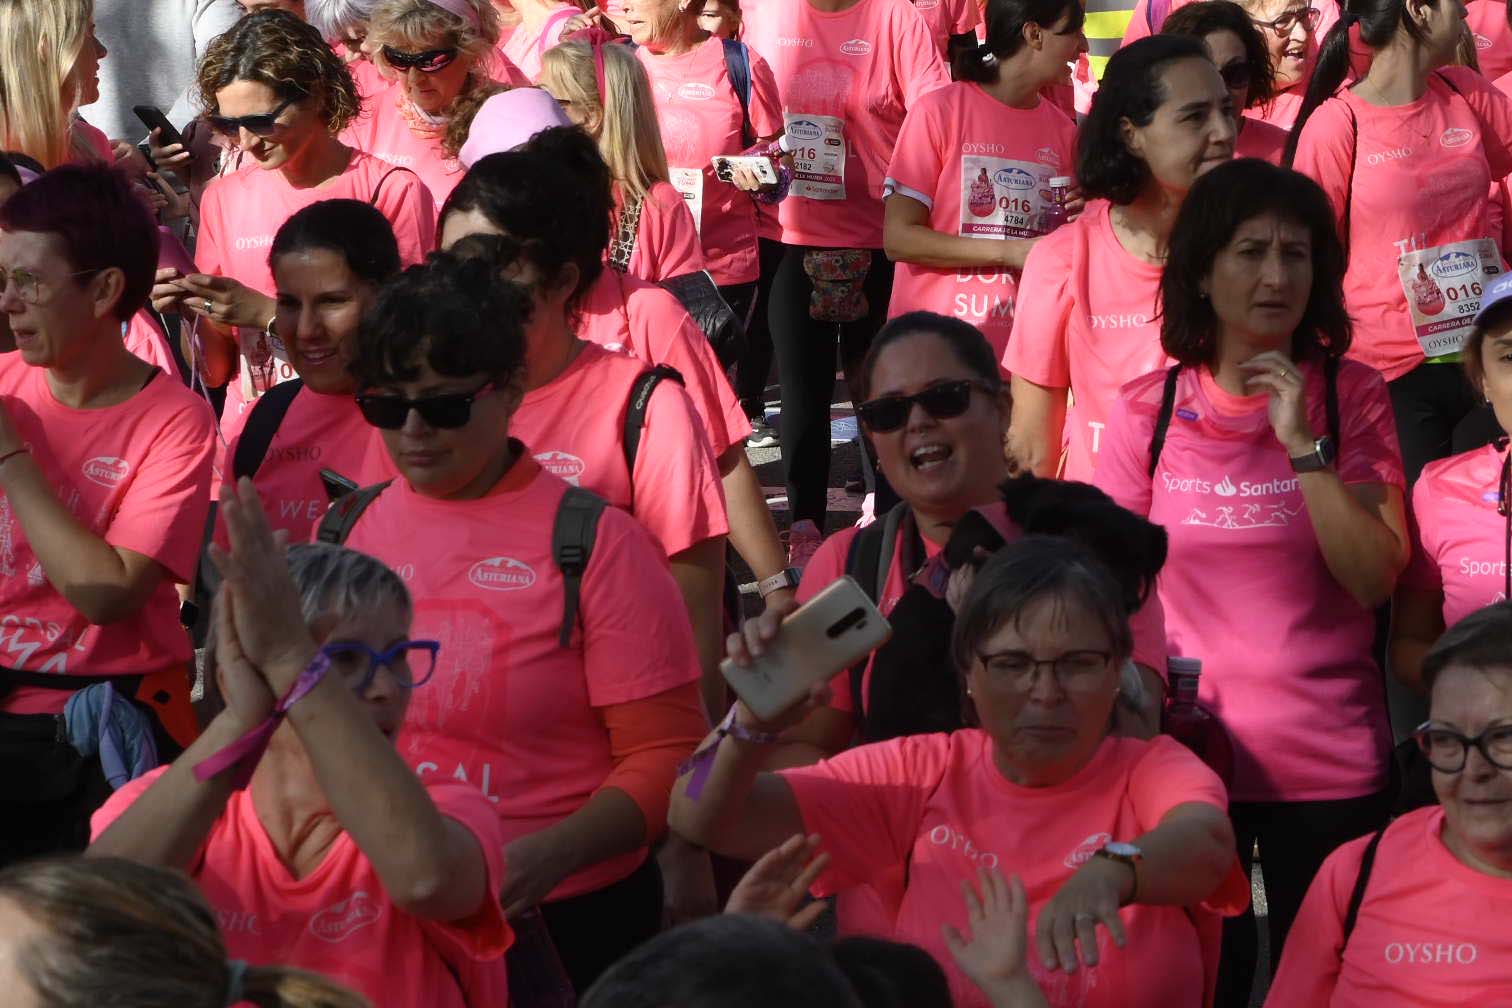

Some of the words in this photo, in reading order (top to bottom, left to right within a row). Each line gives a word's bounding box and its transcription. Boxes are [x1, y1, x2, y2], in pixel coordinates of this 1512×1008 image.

[962, 142, 1005, 154] OYSHO
[1367, 146, 1413, 165] OYSHO
[998, 196, 1031, 213] 016
[1004, 213, 1024, 226] 4784
[1446, 281, 1483, 301] 016
[1162, 471, 1212, 494] Sports
[474, 568, 531, 585] ASTURIANA
[1384, 941, 1478, 965] OYSHO
